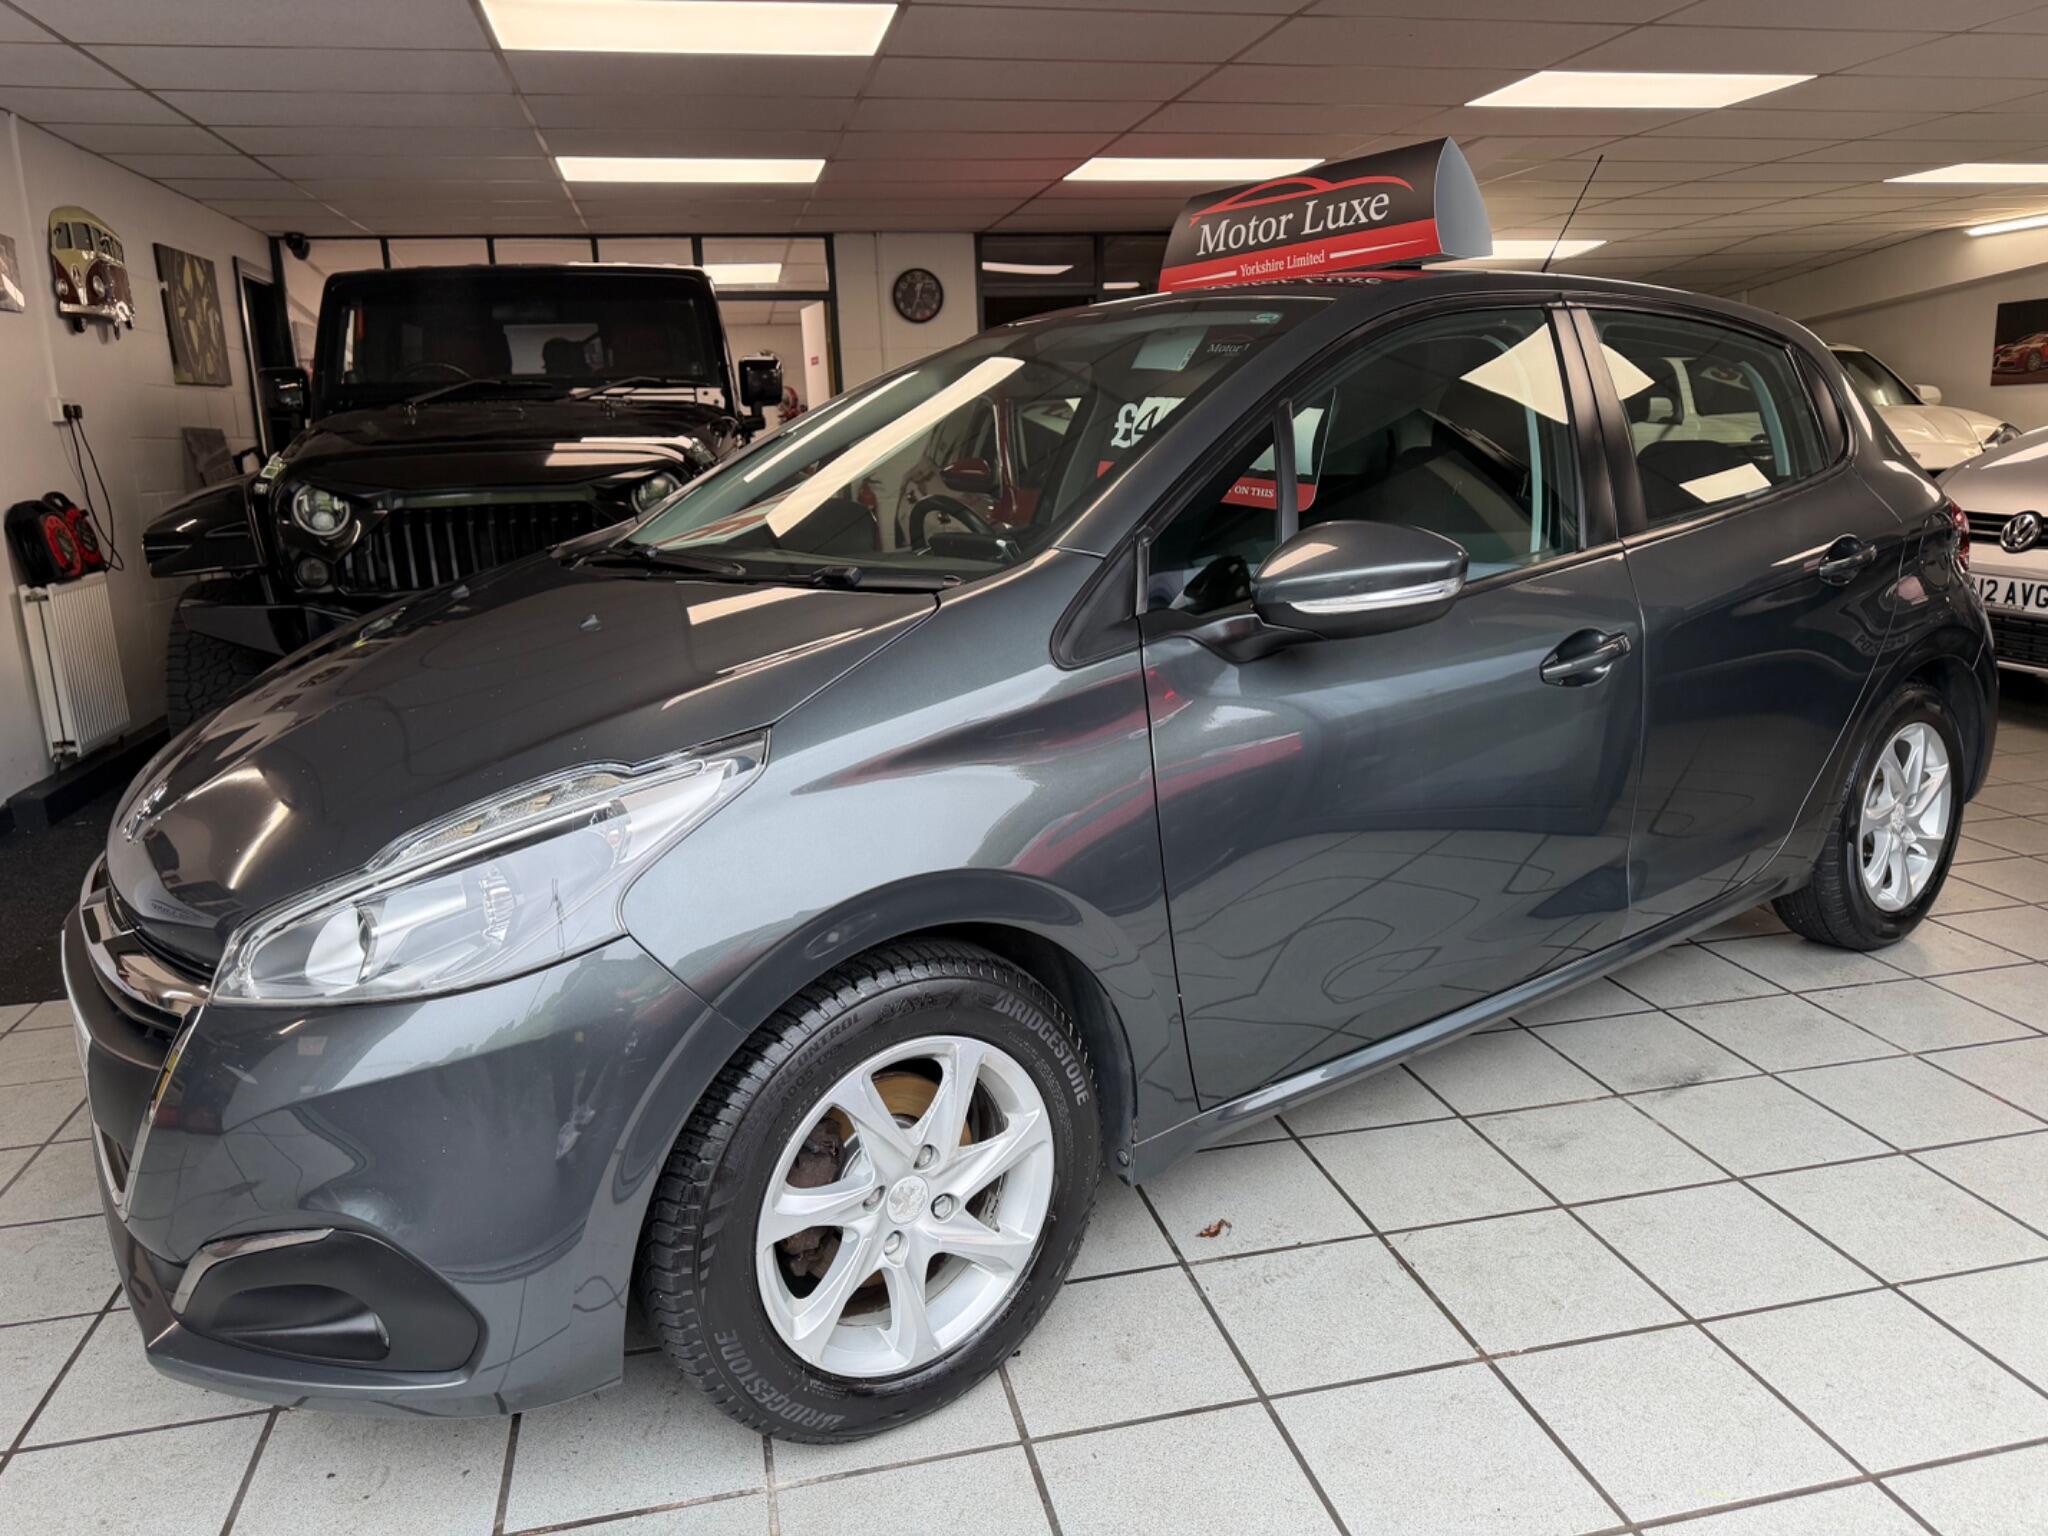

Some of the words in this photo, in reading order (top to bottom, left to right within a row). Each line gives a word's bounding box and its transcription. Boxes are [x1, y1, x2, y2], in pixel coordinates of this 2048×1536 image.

[1196, 213, 1294, 256] Motor
[1301, 193, 1390, 235] Luxe
[1240, 262, 1284, 277] Yorkshire
[1287, 250, 1325, 268] Limited
[1234, 486, 1249, 495] ON
[1251, 487, 1274, 497] THIS
[2004, 581, 2048, 608] AVG
[993, 990, 1089, 1106] BRIDGESTONE
[713, 1328, 846, 1431] BRIDGESTONE
